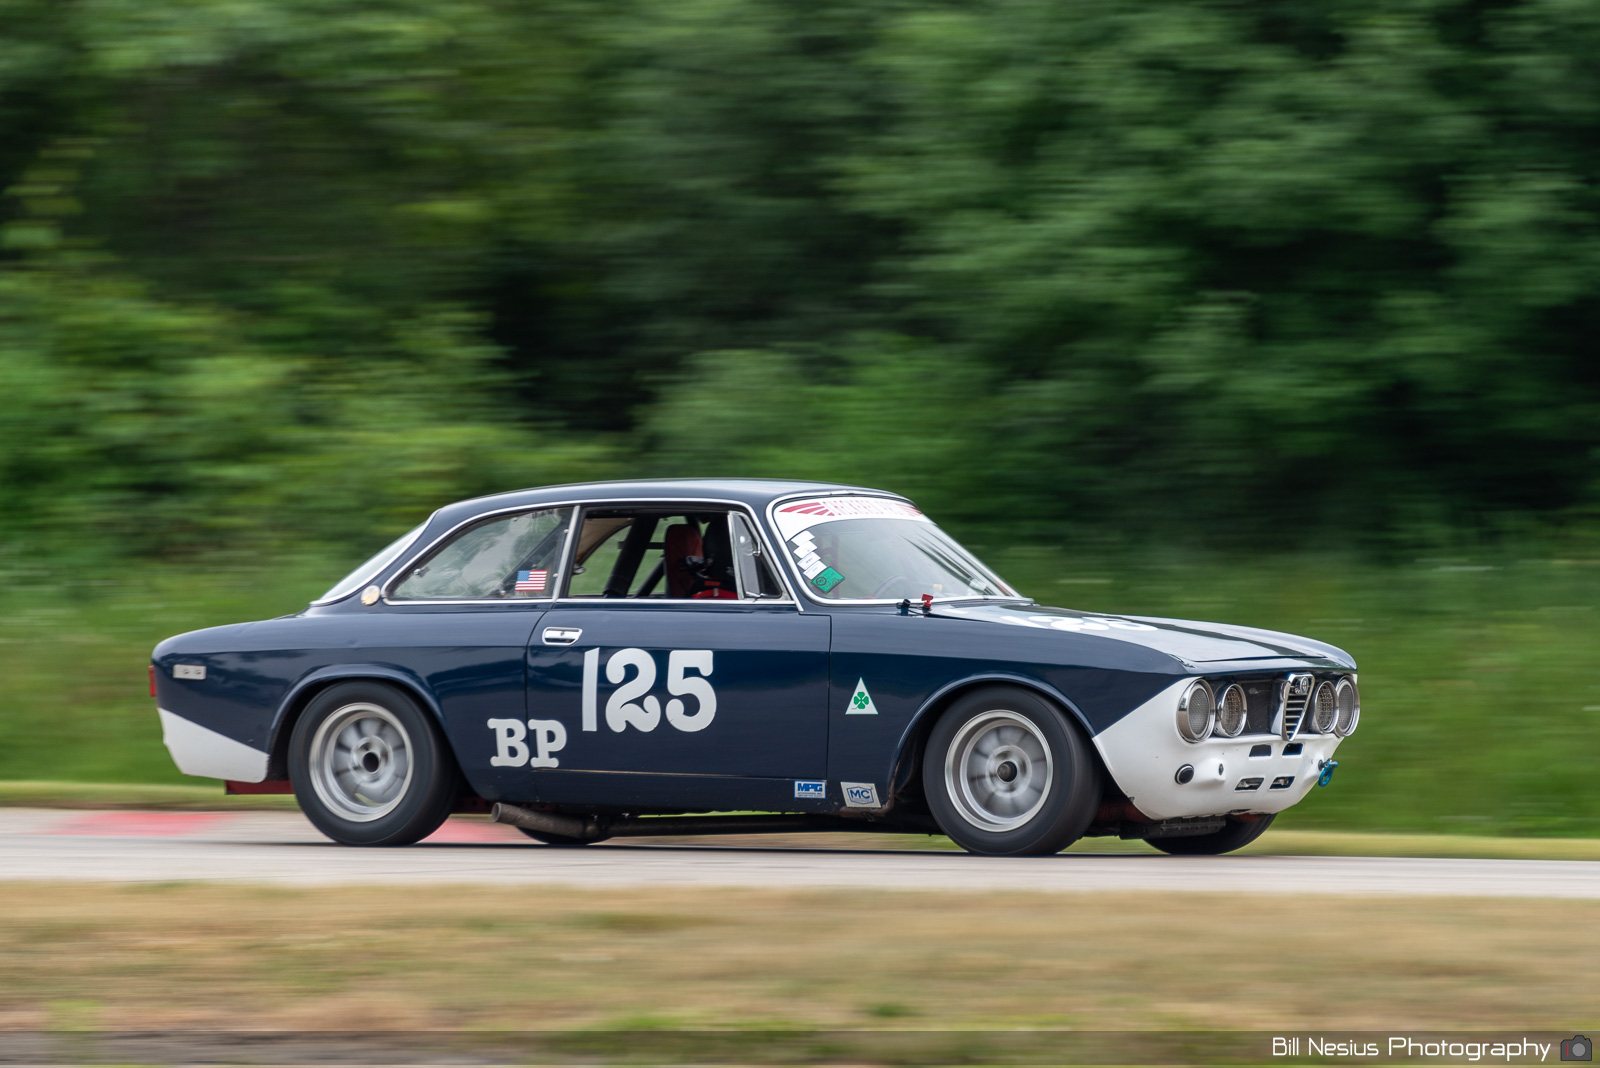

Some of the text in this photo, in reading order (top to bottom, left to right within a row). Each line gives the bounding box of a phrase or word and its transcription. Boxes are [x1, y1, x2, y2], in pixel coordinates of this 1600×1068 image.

[582, 647, 717, 733] 125
[487, 718, 567, 769] BP
[797, 783, 823, 792] MPG
[849, 789, 871, 799] MC
